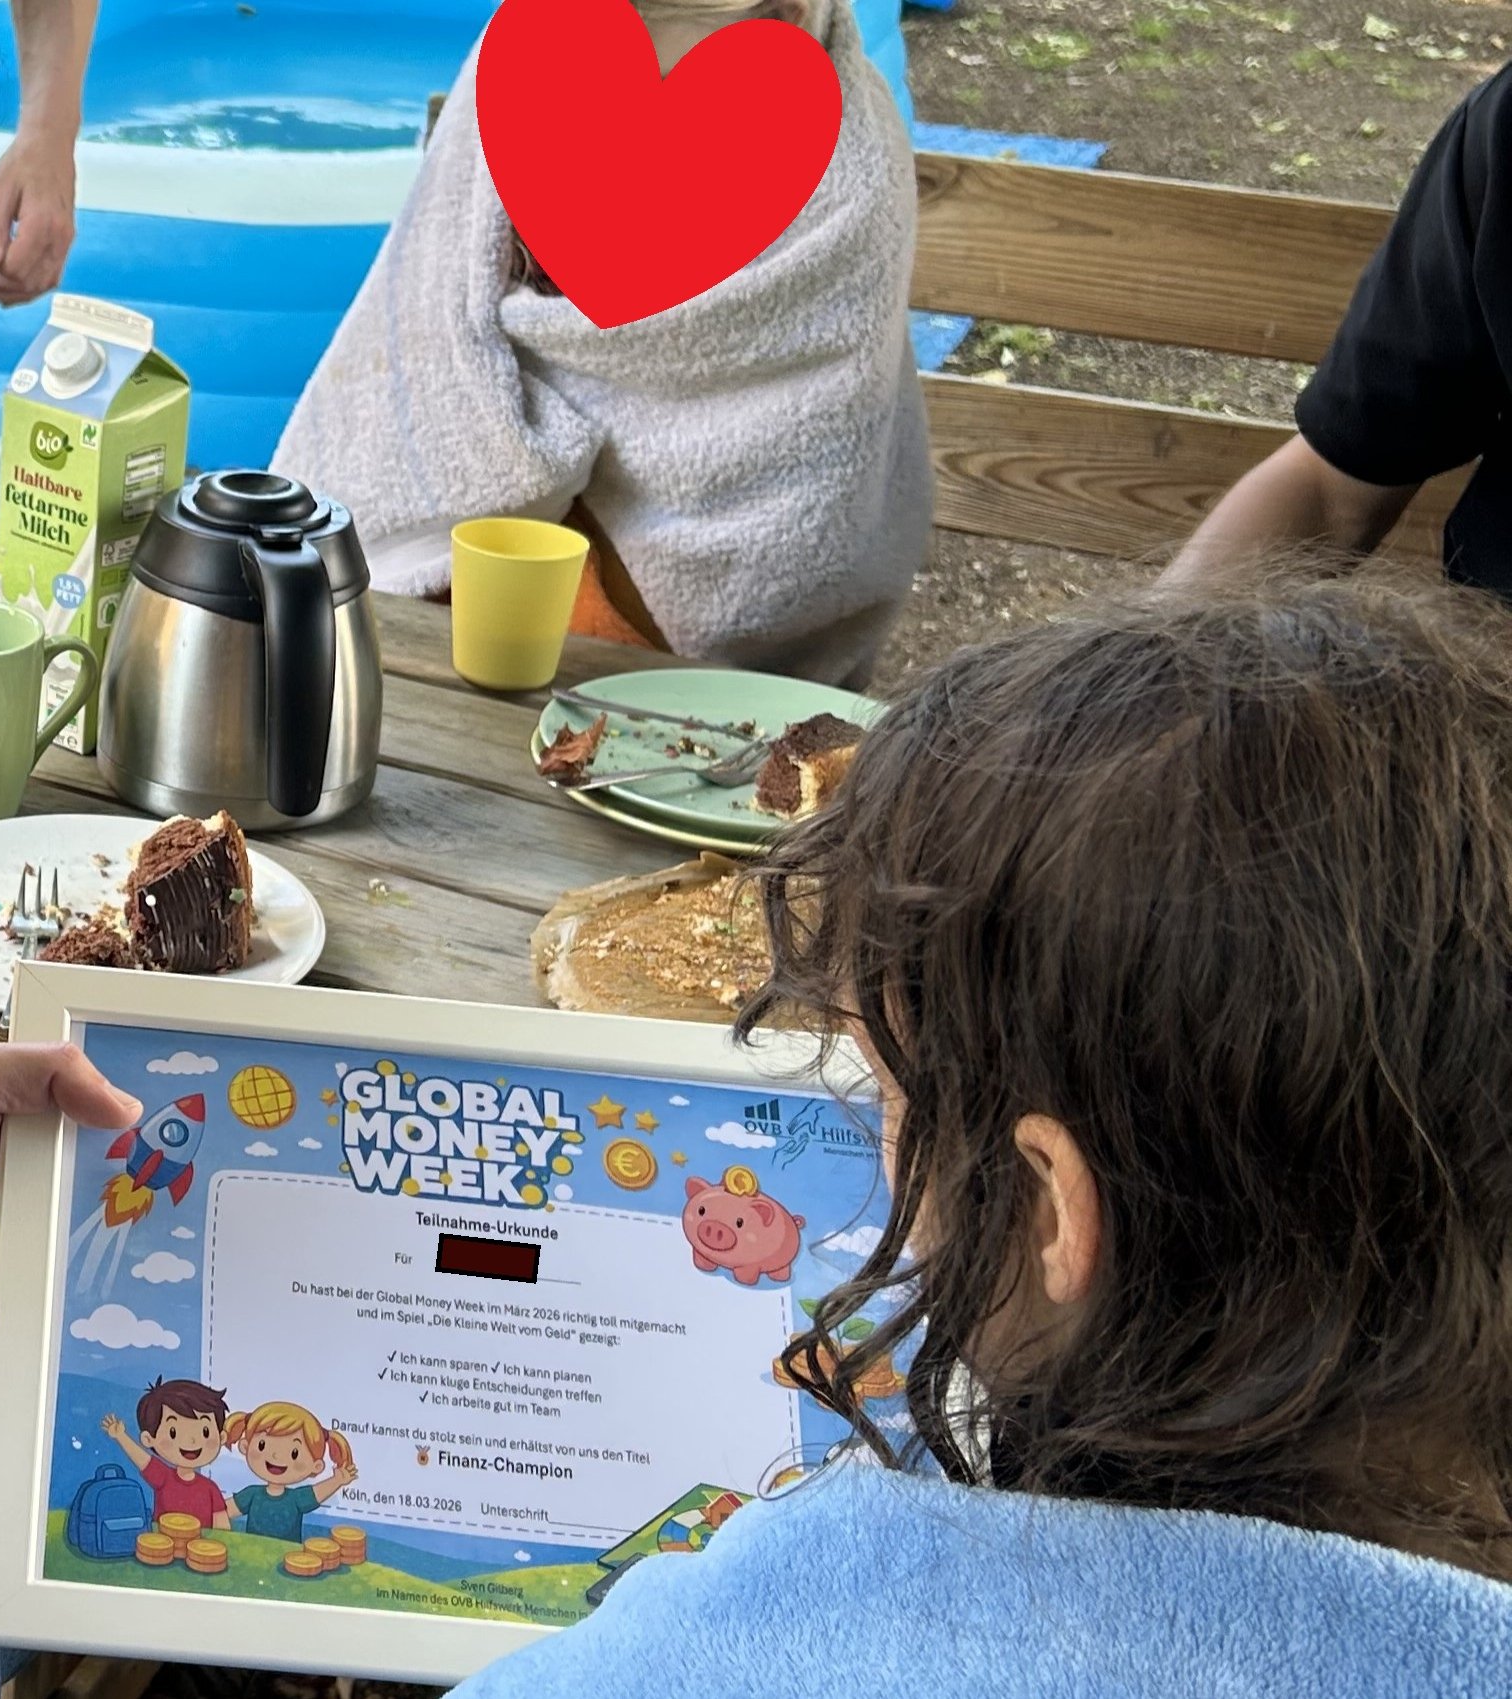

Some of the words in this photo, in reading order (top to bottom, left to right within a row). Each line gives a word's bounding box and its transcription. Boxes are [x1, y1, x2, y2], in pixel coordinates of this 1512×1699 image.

[36, 429, 62, 454] bio
[14, 465, 83, 501] Haltbare
[5, 483, 88, 527] fettarme
[19, 510, 71, 545] Milch
[56, 589, 82, 605] FETT
[342, 1069, 577, 1131] GLOBAL
[343, 1107, 560, 1167] MONEY
[744, 1120, 782, 1136] OVB
[344, 1147, 525, 1204] WEEK
[416, 1211, 559, 1240] Teilnahme-Urkunde
[394, 1252, 413, 1265] Für
[292, 1281, 308, 1294] Du
[310, 1283, 335, 1298] hast
[337, 1286, 354, 1299] bei
[356, 1288, 374, 1301] der
[376, 1290, 413, 1306] Global
[416, 1294, 452, 1312] Money
[454, 1299, 486, 1314] Week
[487, 1302, 501, 1315] im
[504, 1304, 530, 1318] März
[533, 1307, 560, 1321] 2026
[563, 1312, 598, 1328] richtig
[599, 1315, 617, 1329] toll
[619, 1317, 687, 1336] mitgemacht
[357, 1307, 378, 1320] und
[380, 1308, 395, 1321] im
[397, 1310, 425, 1325] Spiel
[454, 1317, 488, 1332] Kleine
[491, 1321, 516, 1335] Welt
[519, 1325, 542, 1337] vom
[579, 1331, 621, 1348] gezeigt:
[399, 1352, 417, 1365] Ich
[420, 1353, 447, 1369] kann
[449, 1358, 488, 1374] sparen
[503, 1363, 521, 1377] Ich
[523, 1365, 551, 1380] kann
[553, 1369, 592, 1385] planen
[390, 1369, 408, 1383] Ich
[410, 1371, 438, 1386] kann
[440, 1376, 470, 1391] kluge
[473, 1378, 563, 1401] Entscheidungen
[565, 1389, 602, 1404] treffen
[451, 1395, 491, 1410] arbeite
[493, 1400, 512, 1414] gut
[514, 1401, 528, 1414] im
[531, 1403, 561, 1418] Team
[331, 1418, 370, 1434] Darauf
[372, 1422, 410, 1439] kannst
[412, 1428, 427, 1440] du
[429, 1430, 456, 1444] stolz
[458, 1433, 483, 1446] sein
[485, 1437, 507, 1450] und
[509, 1439, 553, 1454] erhältst
[555, 1444, 576, 1457] von
[578, 1447, 599, 1460] uns
[601, 1448, 624, 1462] den
[625, 1450, 651, 1466] Titel
[438, 1449, 574, 1481] Finanz-Champion
[342, 1487, 370, 1504] Köln,
[373, 1491, 395, 1505] den
[399, 1494, 462, 1513] 18.03.2026
[481, 1502, 550, 1522] Unterschrift
[391, 1588, 428, 1604] Namen
[430, 1593, 449, 1606] des
[451, 1595, 473, 1609] OVB
[524, 1602, 577, 1620] Menschen
[460, 1579, 486, 1594] Sven
